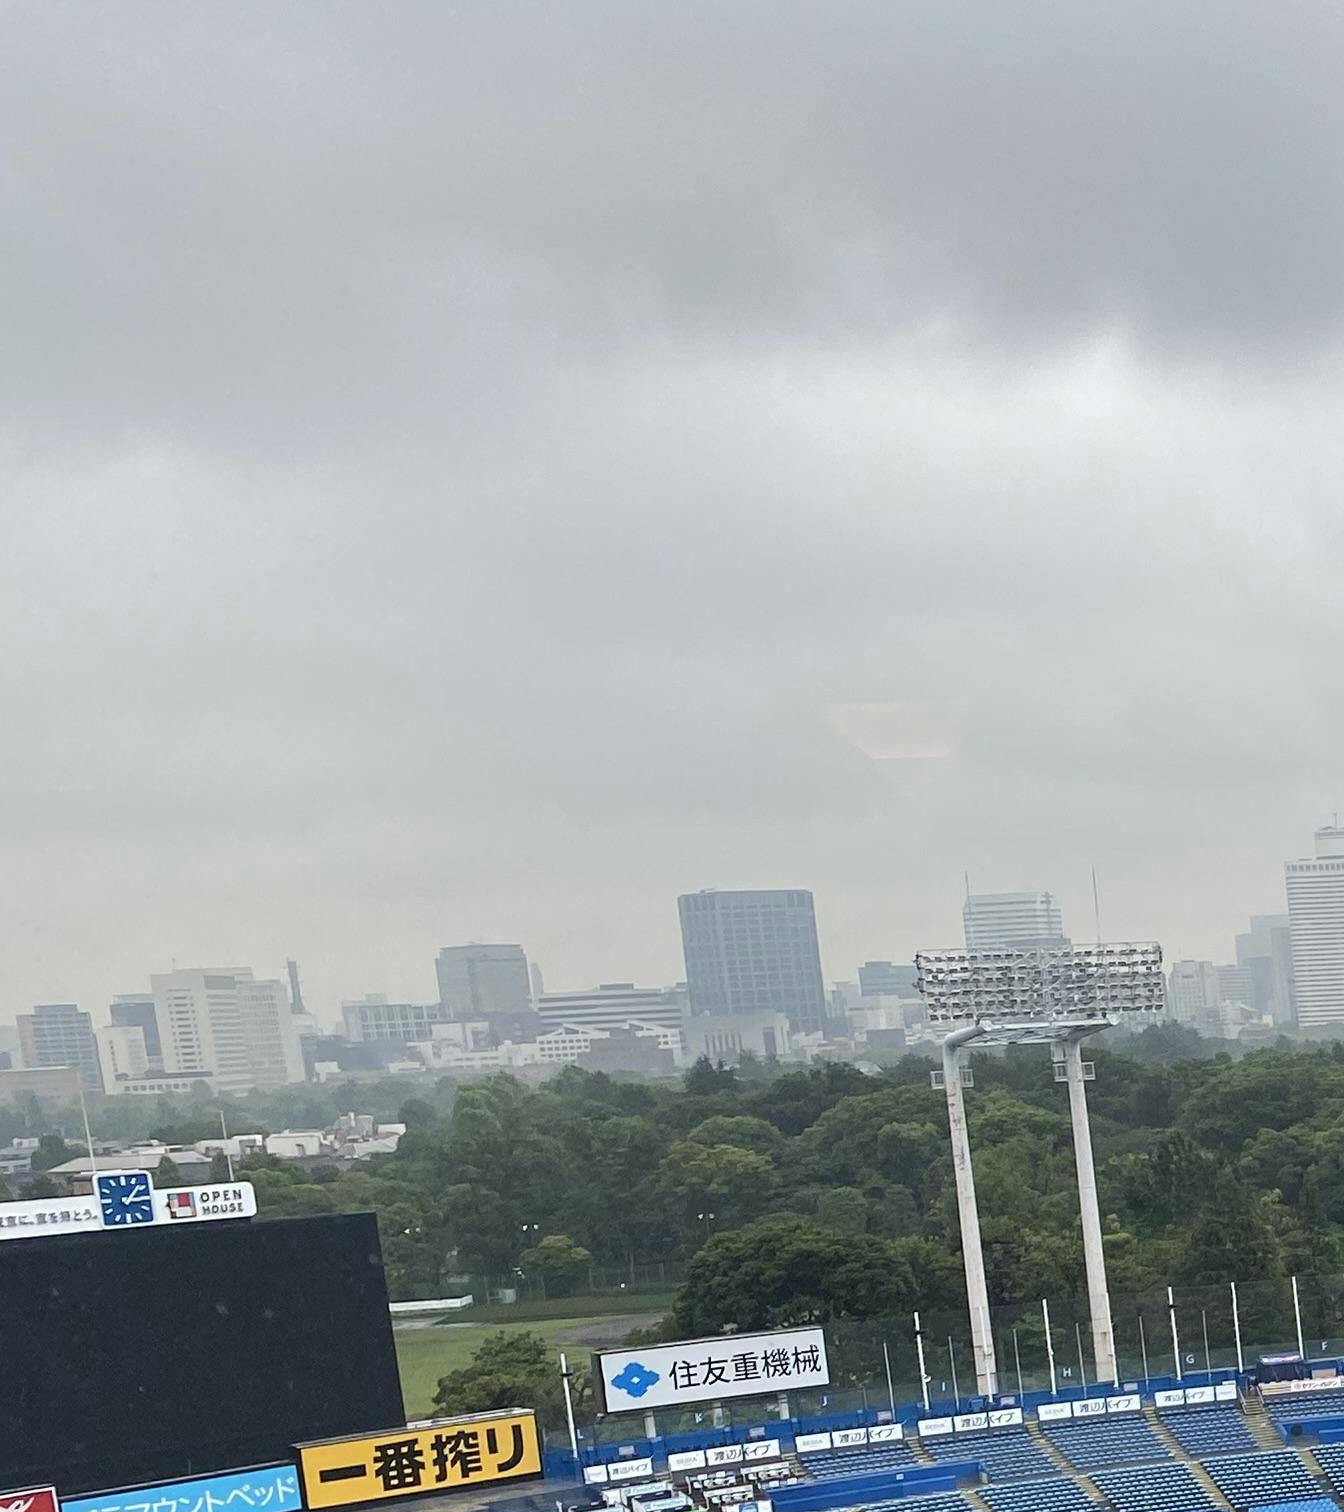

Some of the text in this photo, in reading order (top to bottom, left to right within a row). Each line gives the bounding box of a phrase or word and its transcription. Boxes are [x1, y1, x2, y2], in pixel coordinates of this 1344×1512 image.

[200, 1190, 242, 1203] OPEN
[202, 1202, 244, 1215] HOUSE
[668, 1344, 822, 1391] 住友重機械
[318, 1424, 524, 1492] 一番搾り
